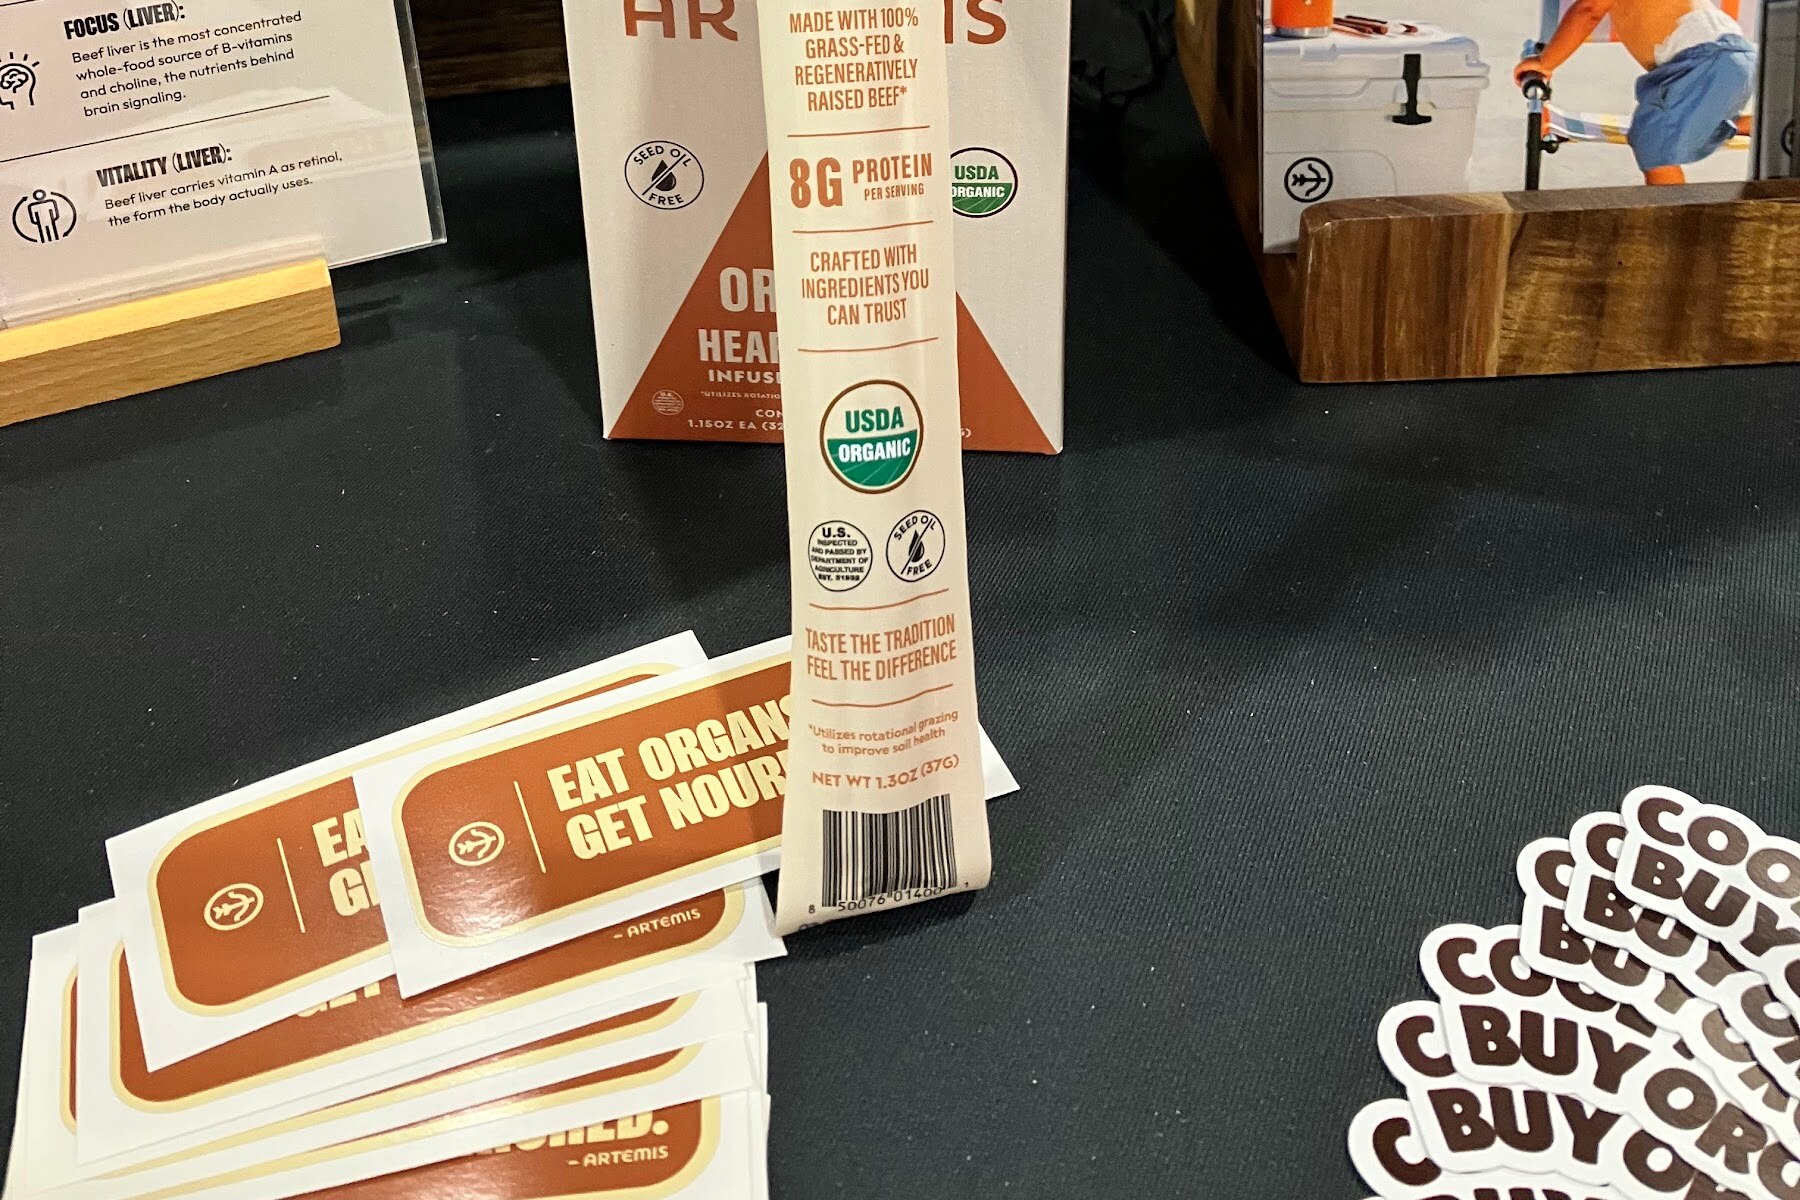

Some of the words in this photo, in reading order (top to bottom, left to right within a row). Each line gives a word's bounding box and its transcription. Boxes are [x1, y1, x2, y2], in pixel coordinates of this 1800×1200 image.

[64, 13, 119, 40] FOCUS
[123, 0, 185, 30] (LIVER):
[789, 11, 834, 34] MADE
[838, 8, 878, 31] WITH
[880, 7, 919, 29] 100%
[72, 47, 104, 63] Beef
[107, 44, 136, 56] liver
[139, 41, 149, 51] is
[152, 37, 174, 48] the
[178, 28, 210, 43] most
[214, 10, 301, 36] concentrated
[805, 34, 889, 60] GRASS-FED
[893, 33, 905, 54] &
[76, 56, 155, 80] whole-food
[158, 51, 202, 65] source
[205, 44, 218, 56] of
[222, 34, 292, 53] B-vitamins
[794, 58, 918, 86] REGENERATIVELY
[81, 84, 106, 99] and
[110, 78, 161, 93] choline,
[164, 71, 186, 83] the
[190, 59, 247, 78] nutrients
[250, 48, 294, 66] behind
[84, 102, 120, 117] brain
[123, 92, 186, 110] signaling.
[807, 89, 864, 112] RAISED
[96, 156, 167, 187] VITALITY
[172, 143, 232, 173] (LIVER):
[632, 144, 665, 167] SEED
[669, 146, 692, 169] OIL
[105, 194, 136, 209] Beef
[139, 190, 167, 203] liver
[170, 180, 215, 195] carries
[217, 169, 266, 185] vitamin
[269, 165, 278, 175] A
[281, 163, 295, 172] as
[789, 156, 843, 209] 8G
[852, 152, 933, 184] PROTEIN
[954, 165, 1000, 180] USDA
[108, 216, 130, 226] the
[133, 209, 166, 221] form
[168, 203, 190, 214] the
[193, 195, 225, 208] body
[229, 183, 278, 201] actually
[282, 178, 313, 189] uses.
[648, 192, 685, 206] FREE
[864, 188, 883, 201] PER
[885, 182, 925, 199] SERVING
[951, 185, 1006, 198] ORGANIC
[810, 248, 880, 273] CRAFTED
[884, 243, 917, 268] WITH
[801, 272, 900, 300] INGREDIENTS
[901, 268, 930, 291] YOU
[827, 304, 860, 326] CAN
[863, 298, 907, 322] TRUST
[845, 405, 904, 433] USDA
[838, 437, 911, 463] ORGANIC
[822, 526, 851, 538] U.S.
[893, 515, 919, 541] SEED
[920, 514, 938, 531] OIL
[906, 558, 933, 577] FREE
[805, 626, 847, 656] TASTE
[850, 632, 882, 655] THE
[883, 613, 956, 651] TRADITION
[806, 654, 837, 681] FEEL
[840, 659, 871, 682] THE
[875, 639, 958, 681] DIFFERENCE
[858, 722, 917, 742] rotational
[917, 710, 959, 733] grazing
[822, 742, 836, 754] to
[837, 742, 890, 757] improve
[892, 737, 912, 753] soil
[913, 726, 945, 747] health
[546, 747, 631, 813] EAT
[811, 770, 841, 788] NET
[847, 774, 871, 789] WT
[875, 769, 919, 790] 1.3OZ
[920, 753, 960, 780] (37G)
[565, 794, 653, 860] GET
[1631, 843, 1800, 958] BUY
[627, 908, 701, 938] ARTEMIS
[1459, 1004, 1652, 1095] BUY
[1427, 1086, 1621, 1165] BUY
[582, 1145, 669, 1167] ARTEMIS
